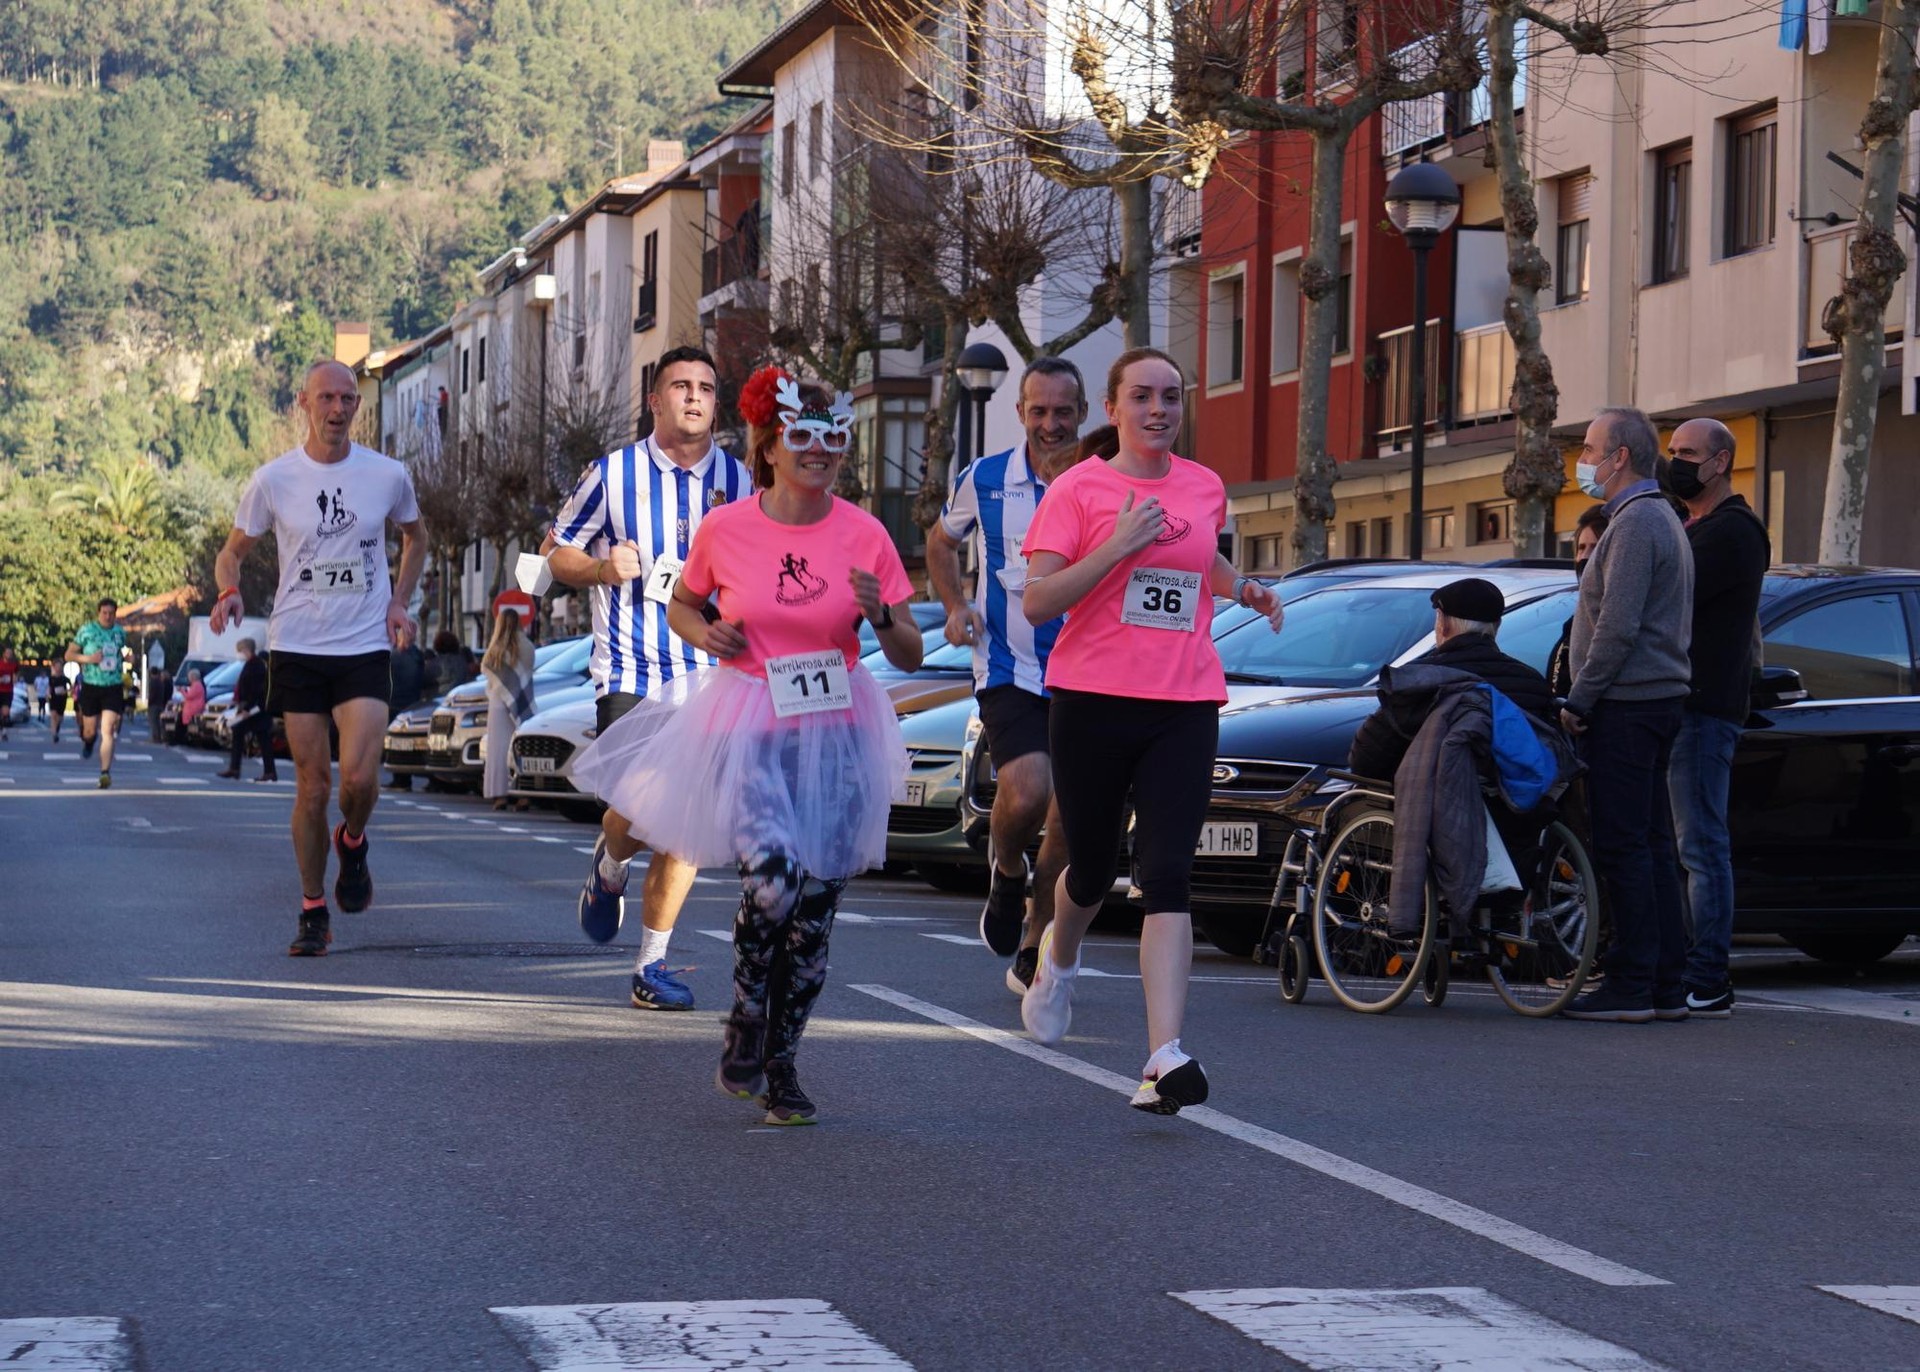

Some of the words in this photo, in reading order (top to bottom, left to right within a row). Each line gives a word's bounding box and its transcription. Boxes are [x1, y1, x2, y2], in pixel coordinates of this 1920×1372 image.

[325, 569, 353, 586] 74
[1133, 570, 1197, 589] herrikrosa.eus
[1143, 586, 1182, 613] 36
[770, 655, 842, 675] herrikrosa.eus
[791, 670, 830, 697] 11
[1221, 827, 1253, 851] HMB
